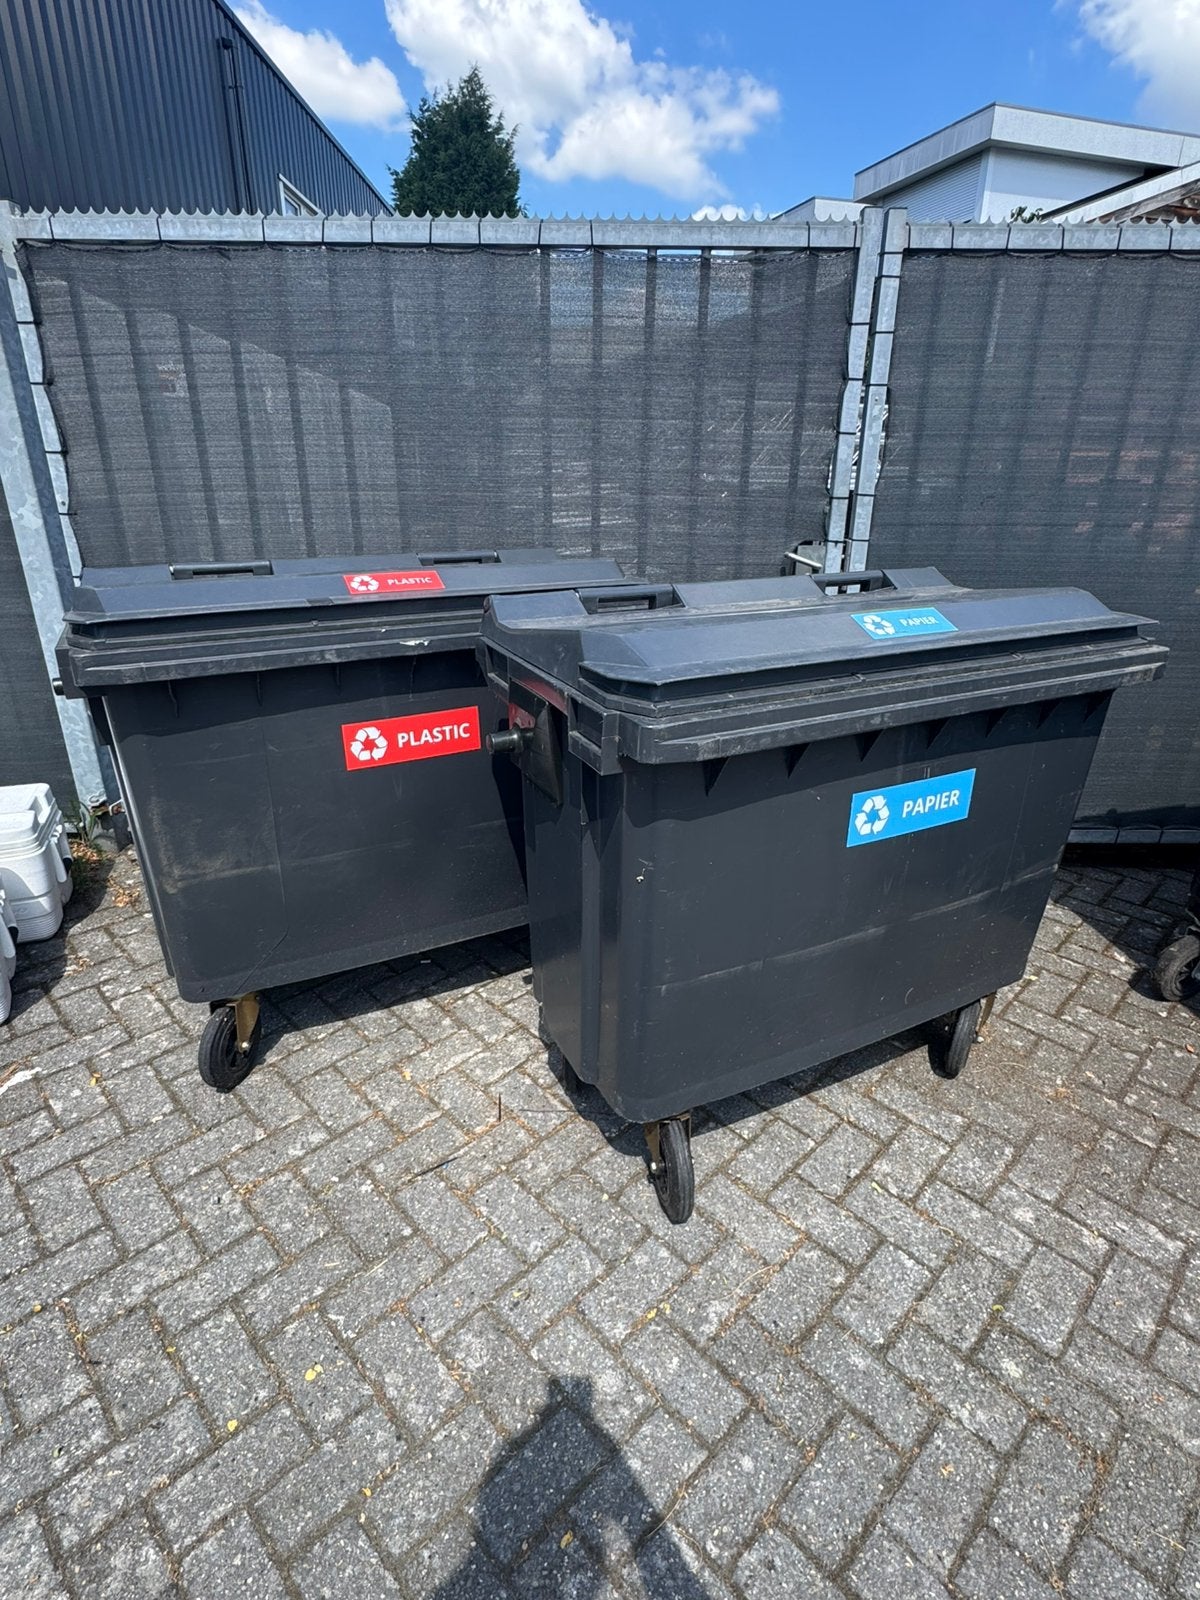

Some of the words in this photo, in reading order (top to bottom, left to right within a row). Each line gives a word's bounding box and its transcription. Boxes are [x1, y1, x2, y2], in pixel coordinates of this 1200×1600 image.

[387, 577, 432, 586] PLASTIC
[900, 616, 939, 627] PAPIER
[397, 723, 470, 748] PLASTIC
[902, 789, 960, 818] PAPIER
